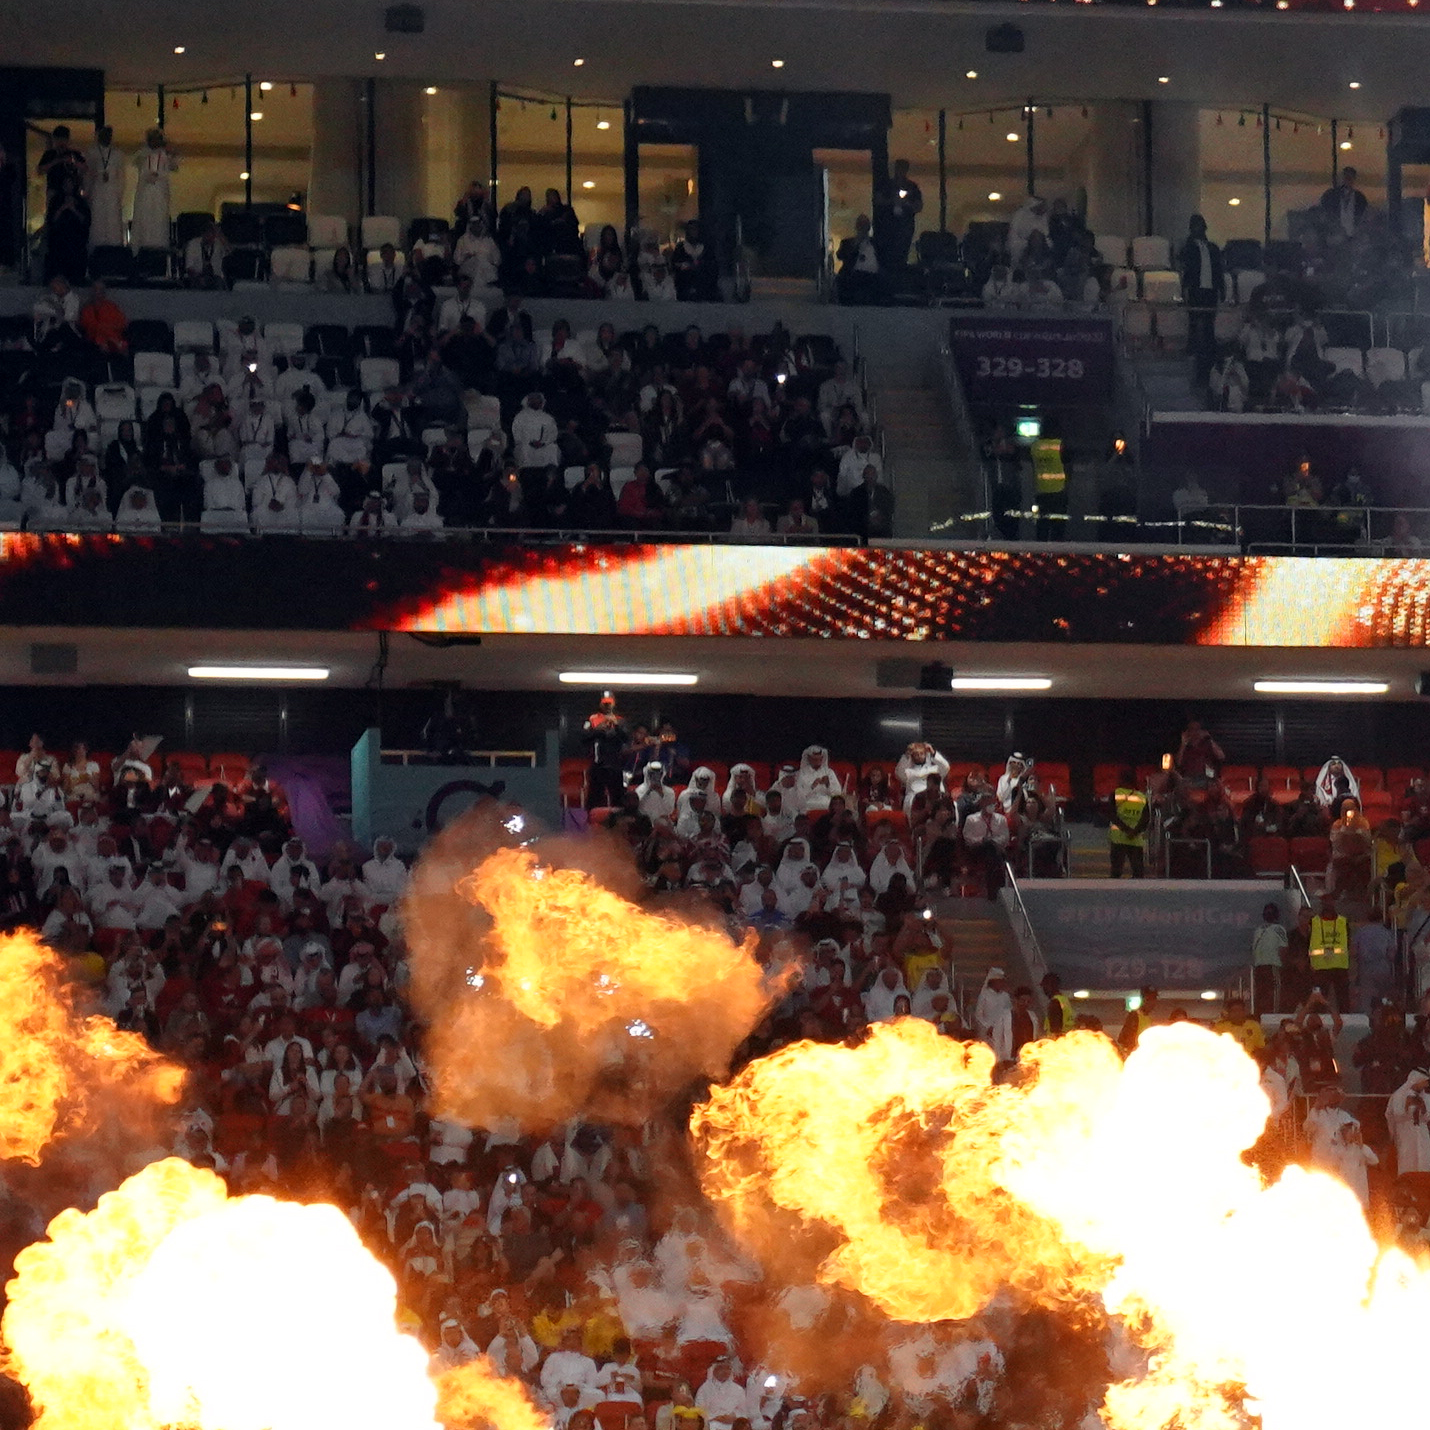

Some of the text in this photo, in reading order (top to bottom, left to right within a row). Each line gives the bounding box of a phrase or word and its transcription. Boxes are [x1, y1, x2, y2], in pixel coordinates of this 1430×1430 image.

[976, 356, 1084, 379] 329-328
[1058, 905, 1251, 926] #FIFAWorldCup
[1104, 956, 1206, 979] 129-128
